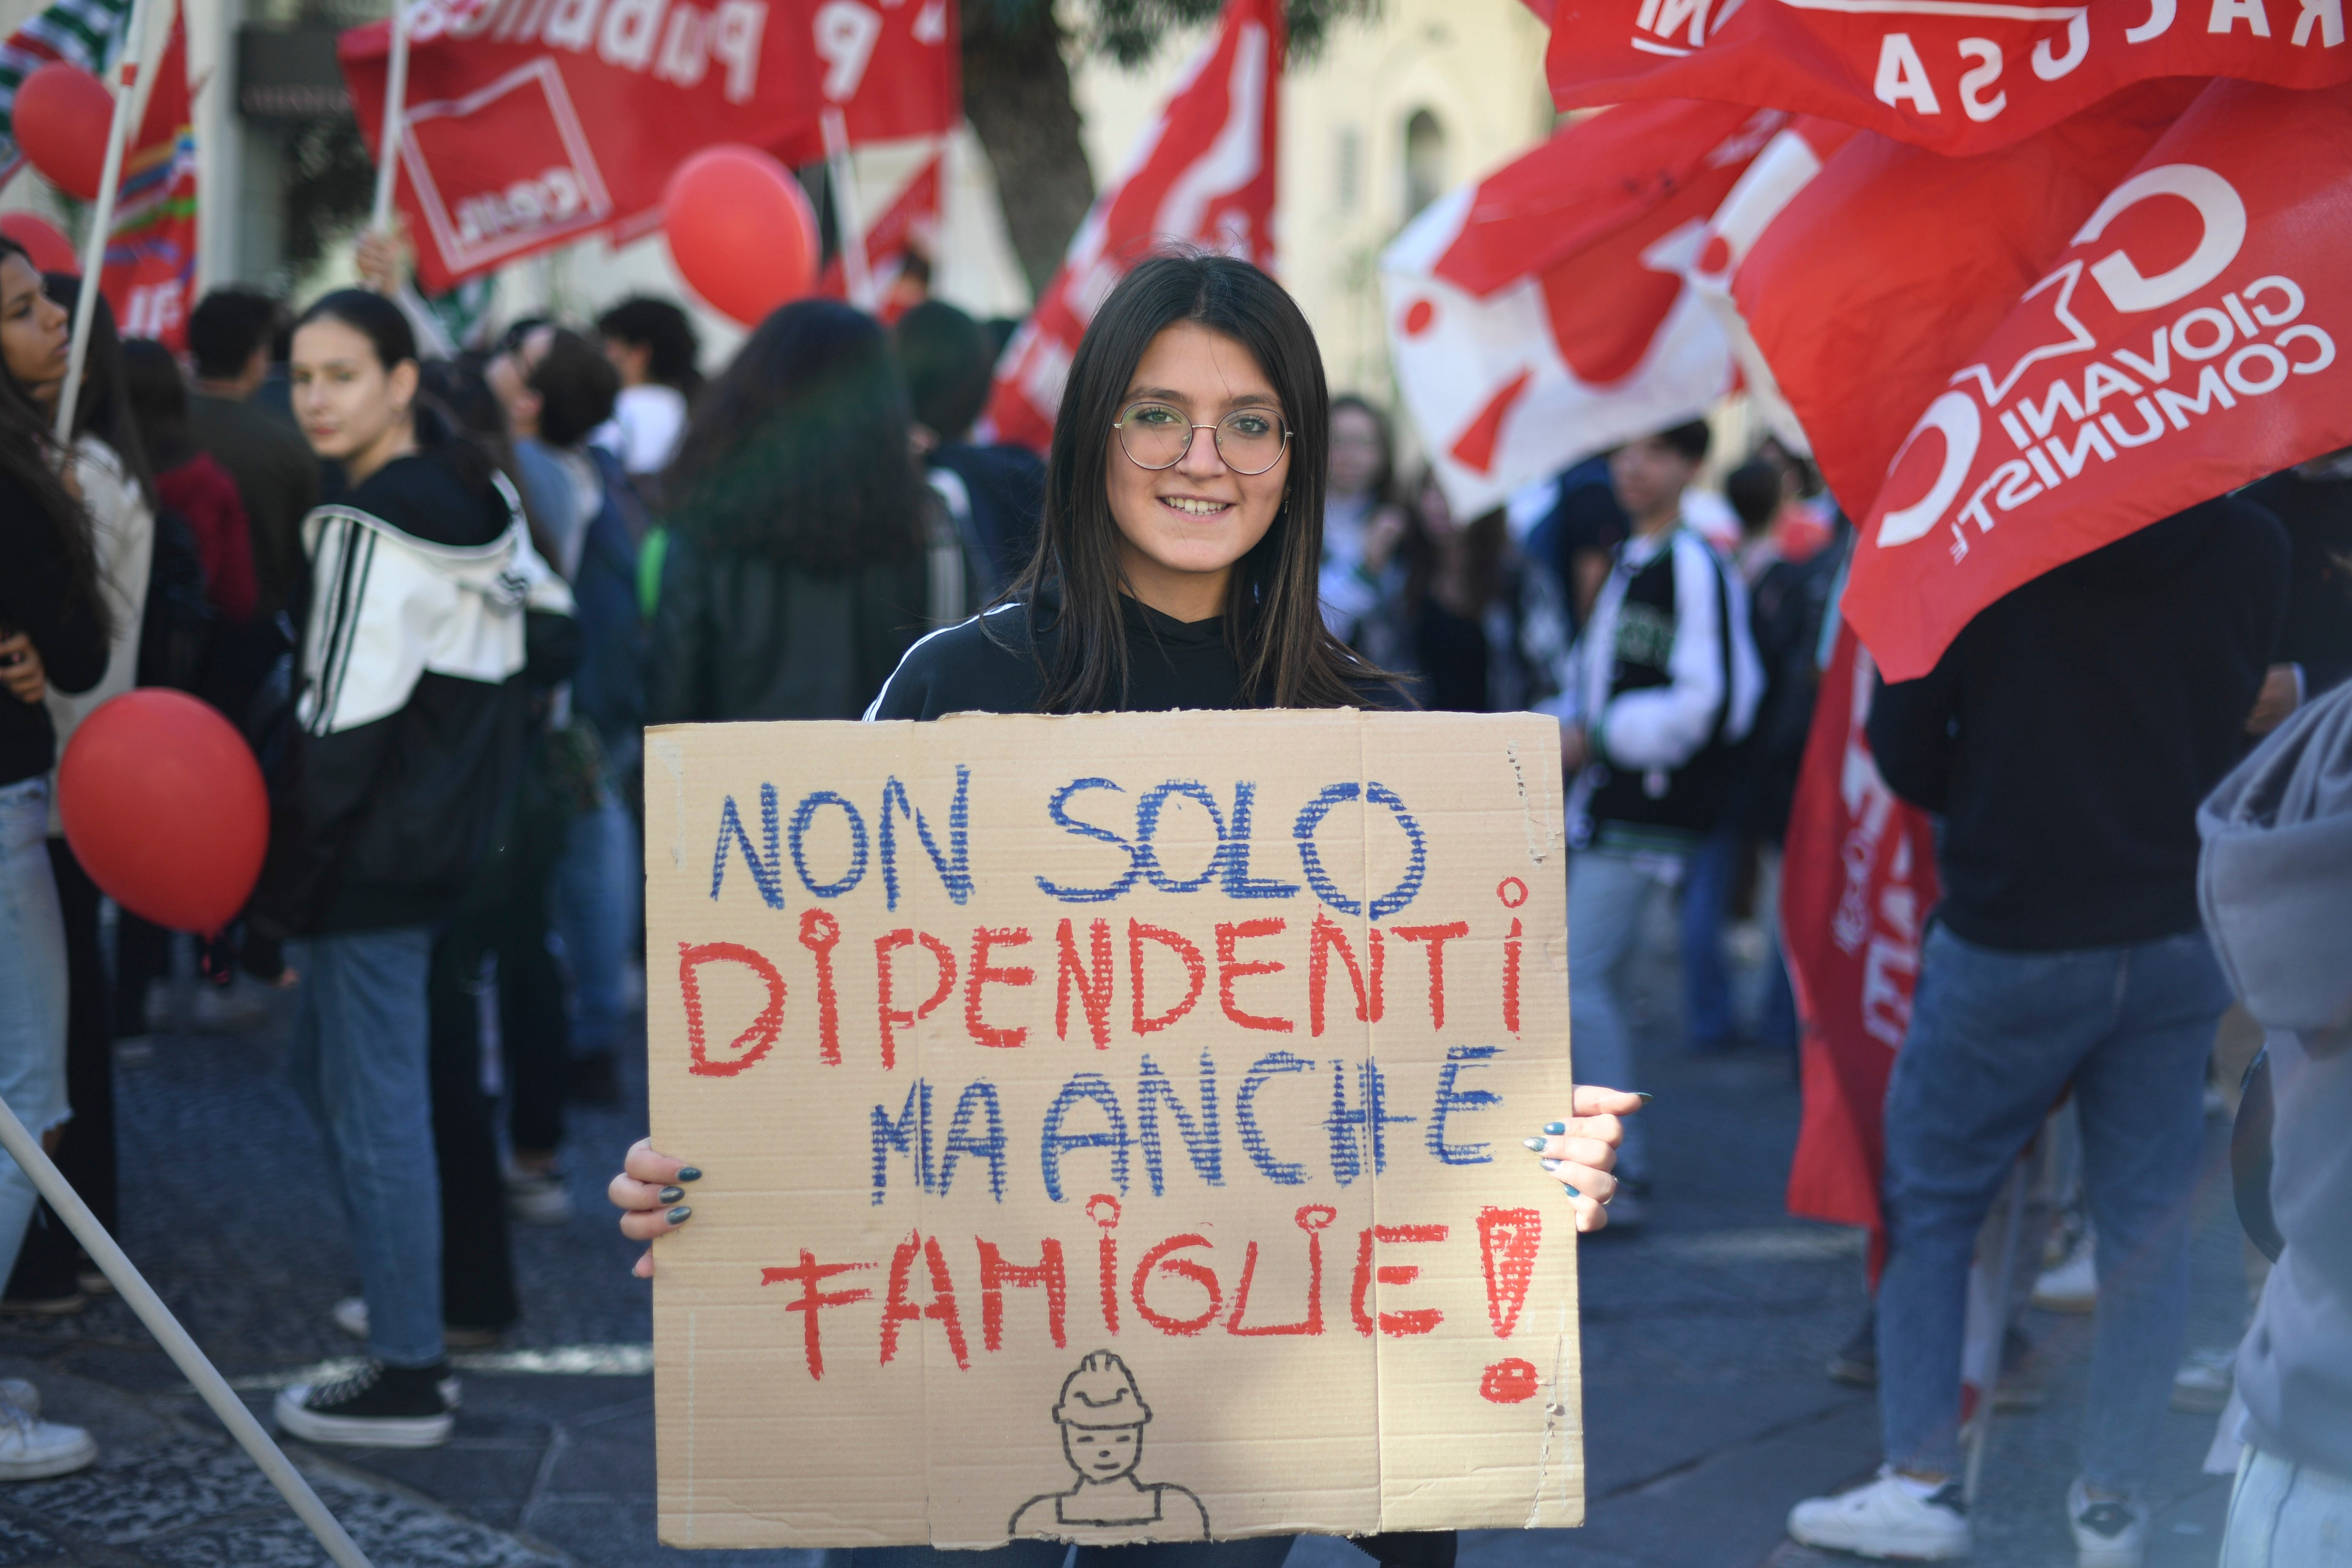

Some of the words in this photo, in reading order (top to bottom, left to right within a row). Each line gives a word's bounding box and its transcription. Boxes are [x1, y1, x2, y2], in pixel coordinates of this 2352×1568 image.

[711, 764, 974, 912] NON
[1036, 776, 1427, 920] SOLO
[871, 1078, 1008, 1206] MA
[1040, 1046, 1503, 1202] ANCHE
